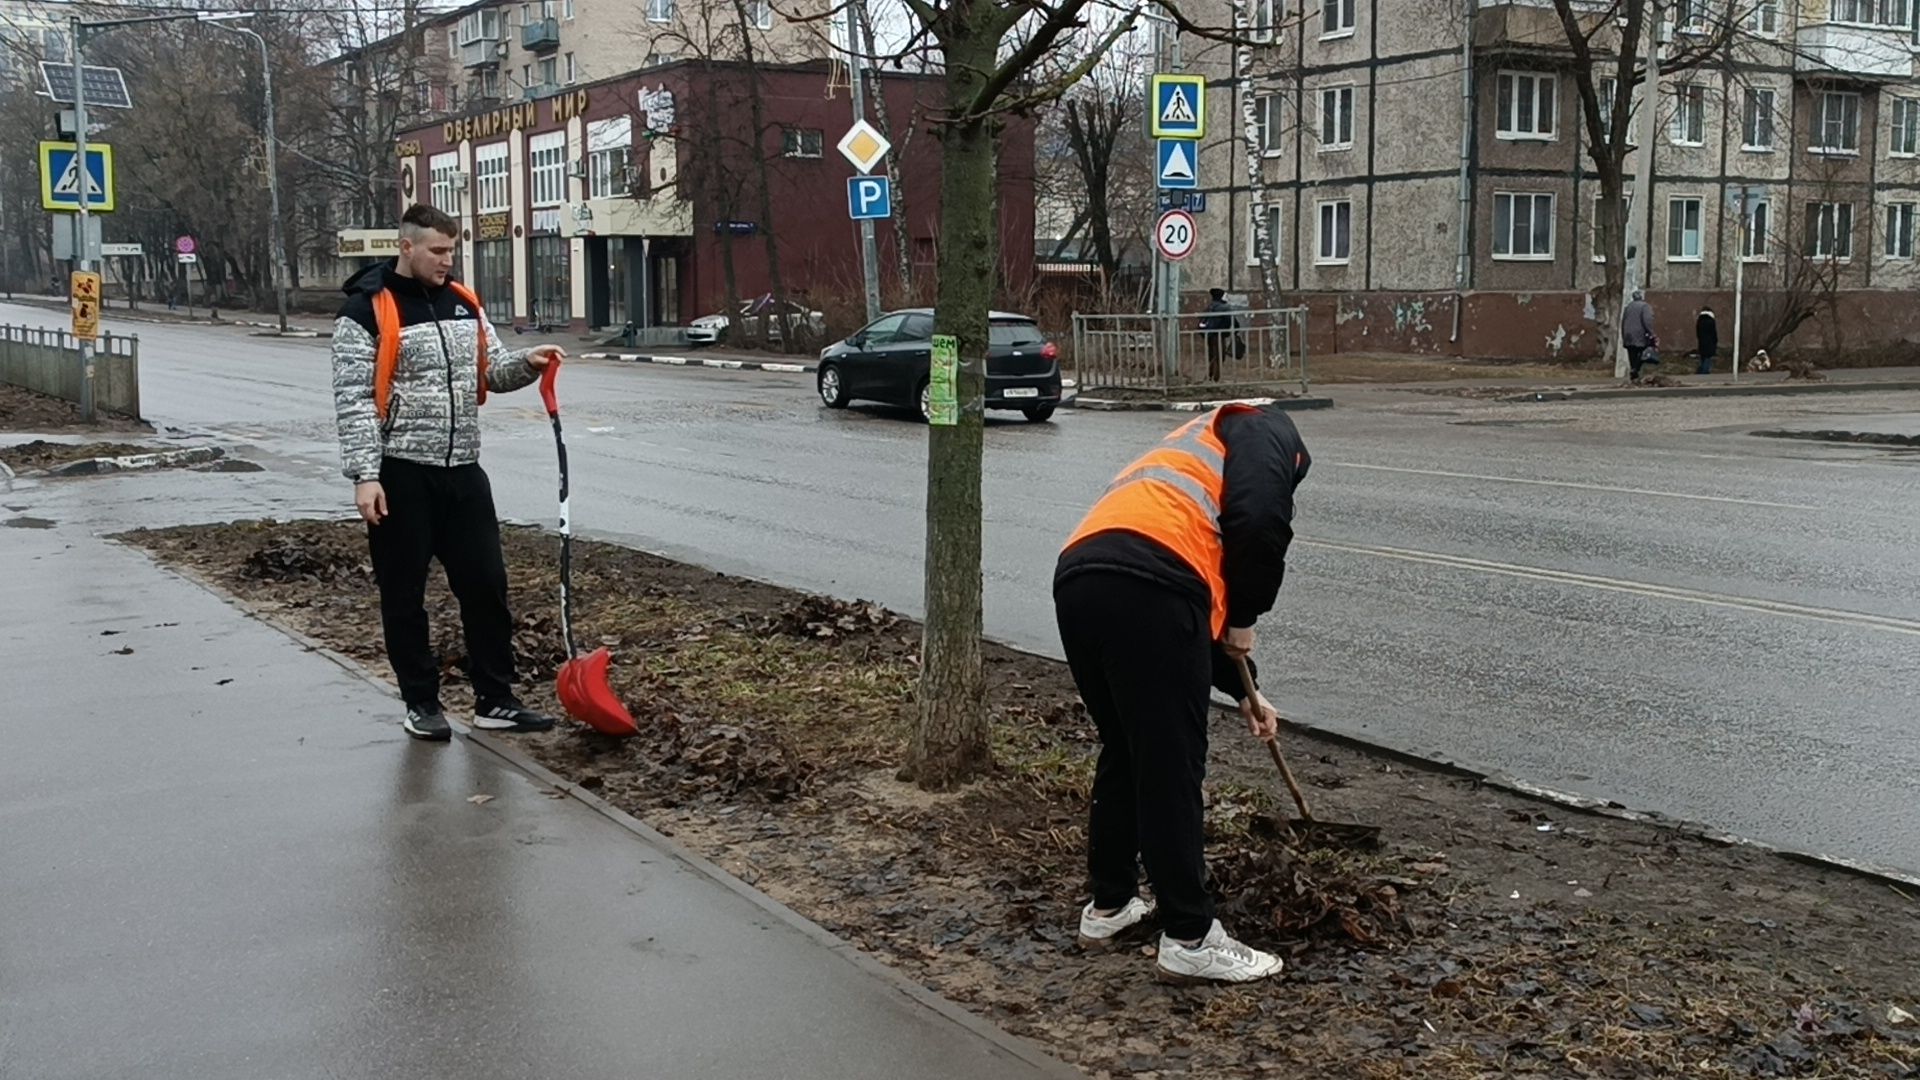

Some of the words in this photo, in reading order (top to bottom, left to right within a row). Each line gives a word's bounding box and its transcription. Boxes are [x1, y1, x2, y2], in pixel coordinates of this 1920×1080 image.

[443, 101, 536, 143] ЮВЕЛИРНЫЙ
[551, 88, 588, 122] МИР
[859, 181, 881, 213] P
[1165, 224, 1188, 244] 20
